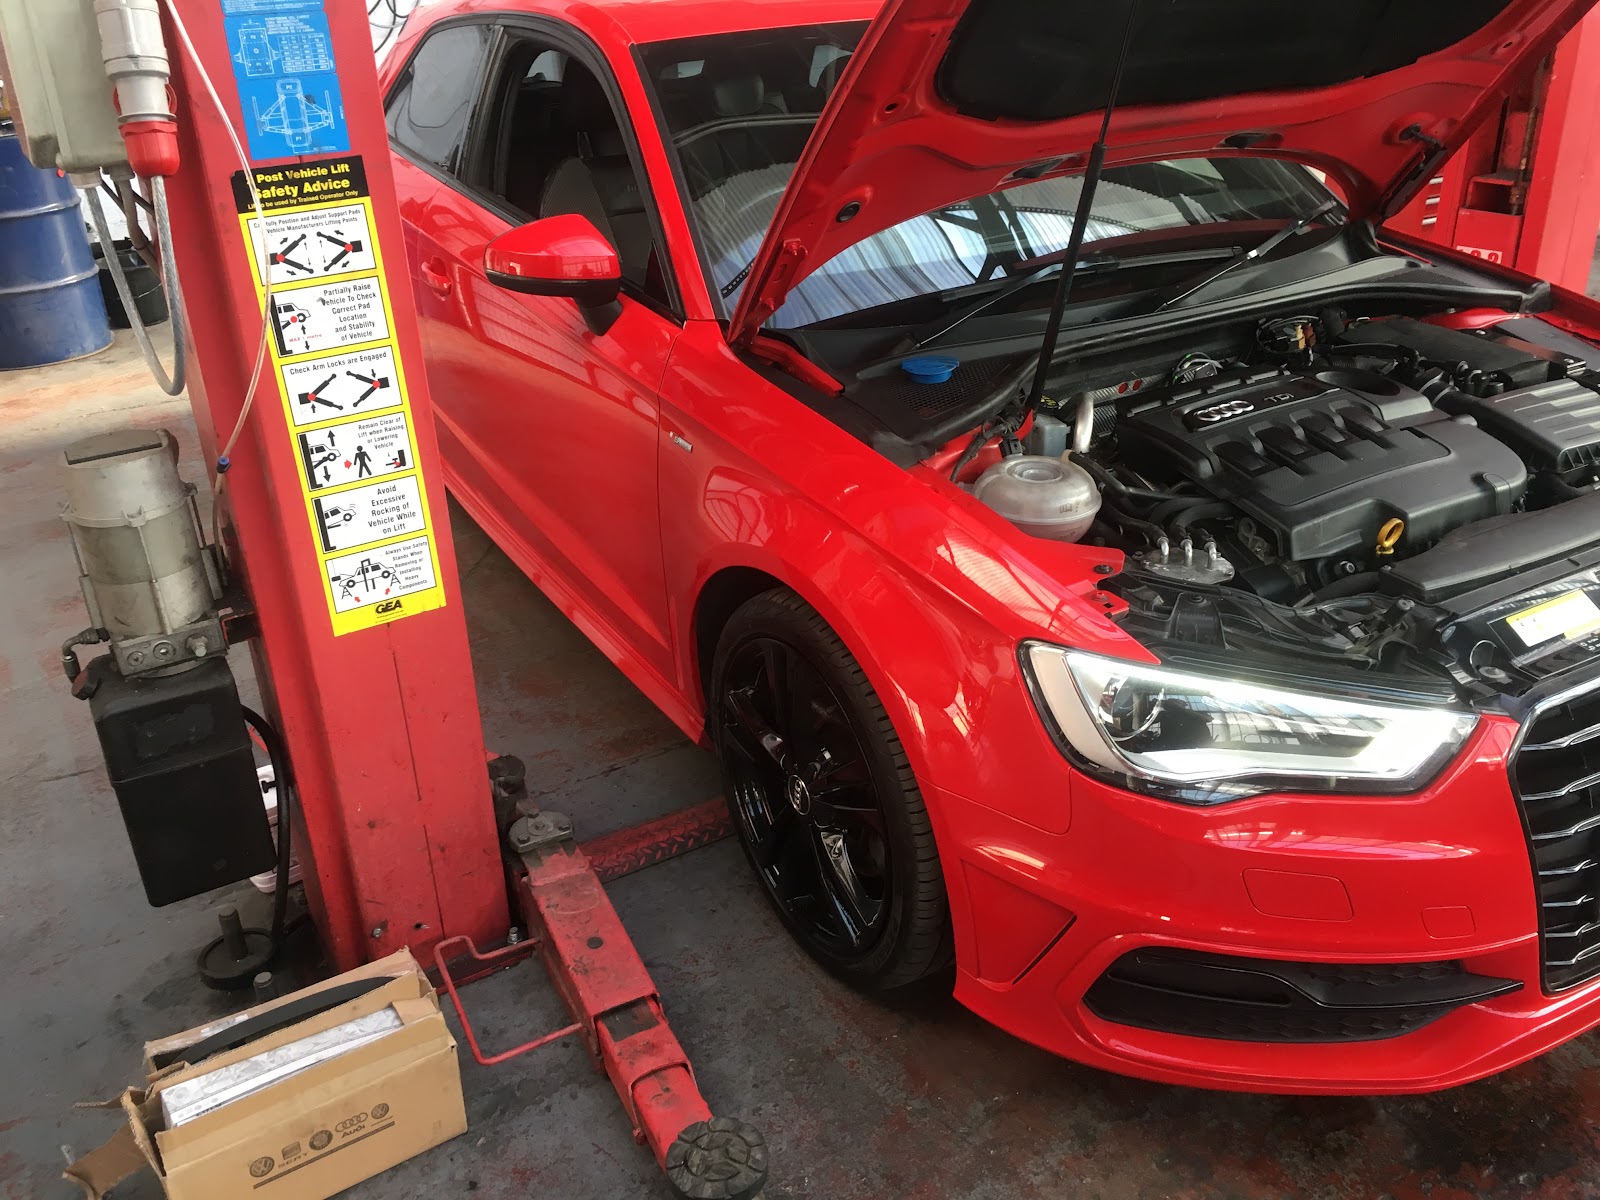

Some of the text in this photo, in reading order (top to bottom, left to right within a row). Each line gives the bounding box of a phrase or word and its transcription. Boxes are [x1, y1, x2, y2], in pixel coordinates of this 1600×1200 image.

[256, 172, 283, 183] Post
[285, 167, 328, 179] Vehicle
[331, 164, 350, 174] Lift
[303, 179, 350, 193] Advice
[320, 192, 344, 200] Operator
[328, 211, 347, 219] Support
[287, 222, 323, 231] Manufacturers
[324, 287, 351, 296] Partially
[357, 292, 376, 301] Check
[332, 302, 370, 314] Correct Pad
[339, 313, 367, 322] Location
[349, 320, 375, 330] Stability
[349, 331, 372, 339] Vehicle
[290, 365, 310, 374] Check
[313, 363, 325, 371] Arm
[327, 360, 345, 368] Locks
[360, 352, 386, 362] Engaged
[1264, 393, 1294, 402] TDI
[358, 422, 378, 430] Remain
[374, 434, 398, 442] Lowering
[377, 485, 396, 495] Avoid
[371, 494, 405, 506] Excessive
[372, 506, 400, 516] Rocking
[368, 511, 416, 527] Vehicle While
[394, 523, 405, 531] Lift
[395, 560, 417, 568] Removing
[400, 566, 421, 575] Installing
[399, 580, 427, 590] Components
[376, 599, 403, 614] GEA
